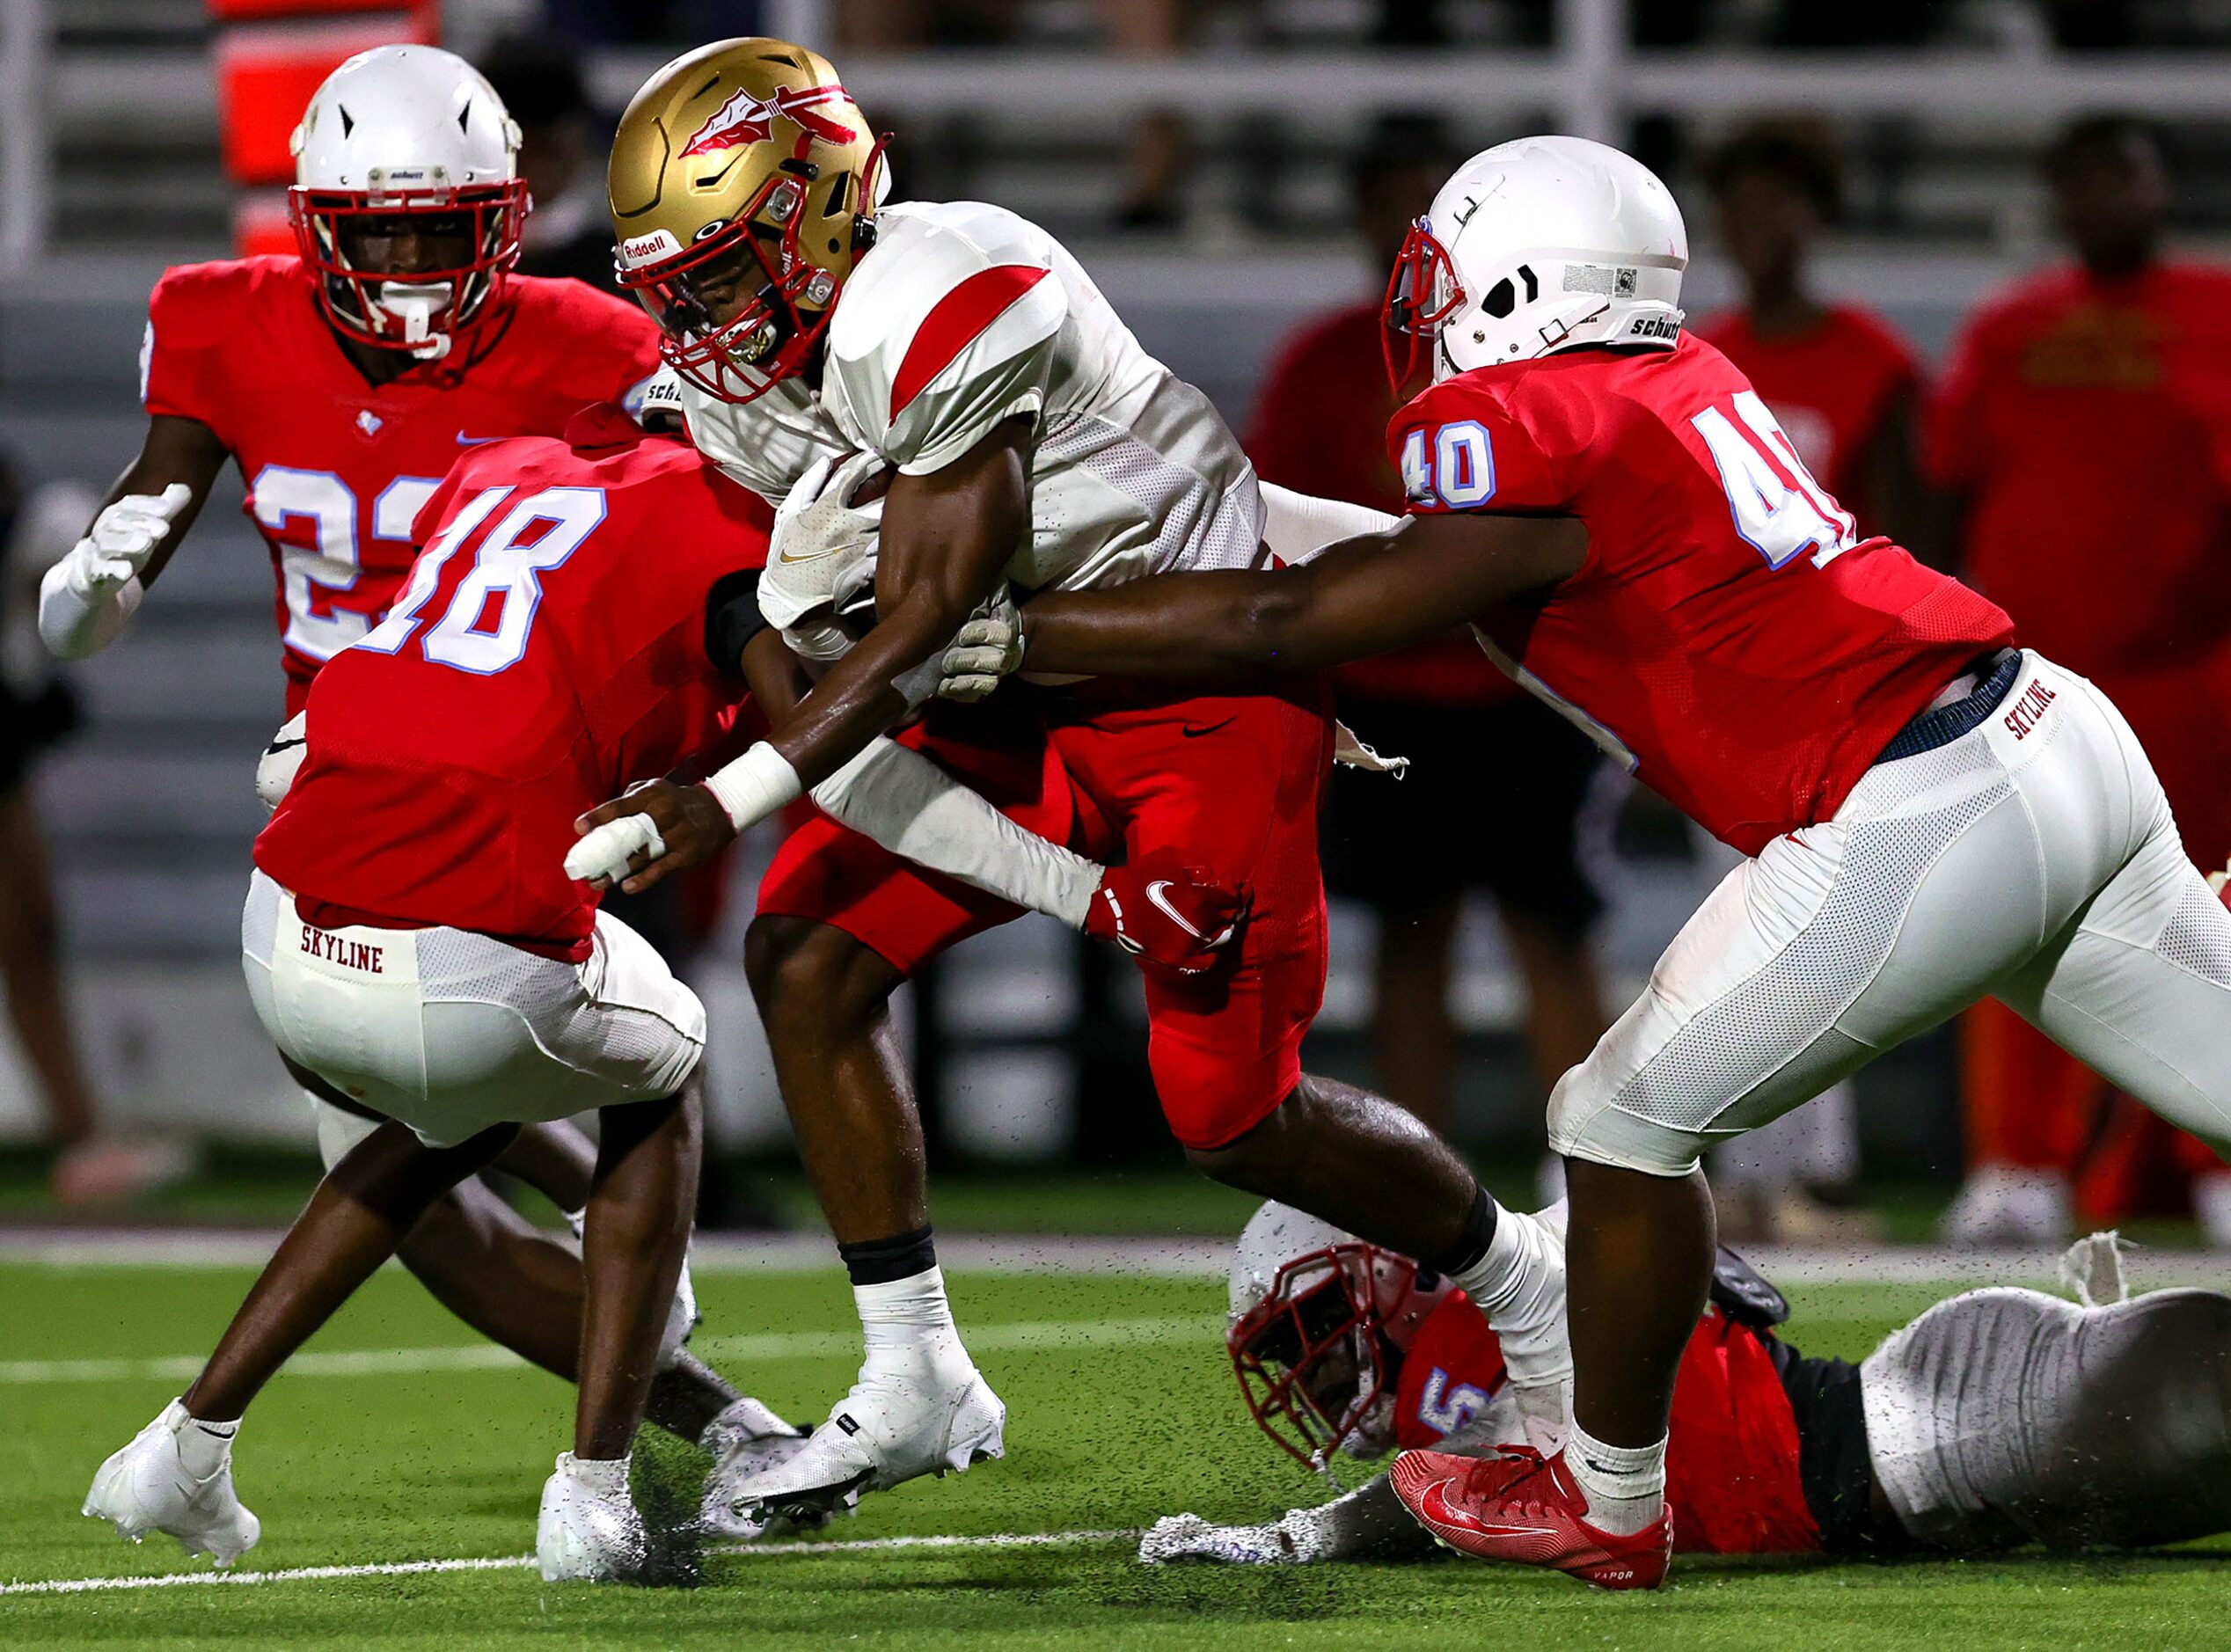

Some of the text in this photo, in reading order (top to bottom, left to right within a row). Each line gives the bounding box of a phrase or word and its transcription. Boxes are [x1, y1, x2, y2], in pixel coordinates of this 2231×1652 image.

[625, 236, 666, 259] Riddell
[1401, 420, 1496, 509] 40
[1689, 390, 1857, 571] 40
[348, 485, 609, 676] 18
[2004, 678, 2057, 741] SKYLINE
[301, 925, 384, 974] SKYLINE
[1594, 1570, 1634, 1581] VAPOR
